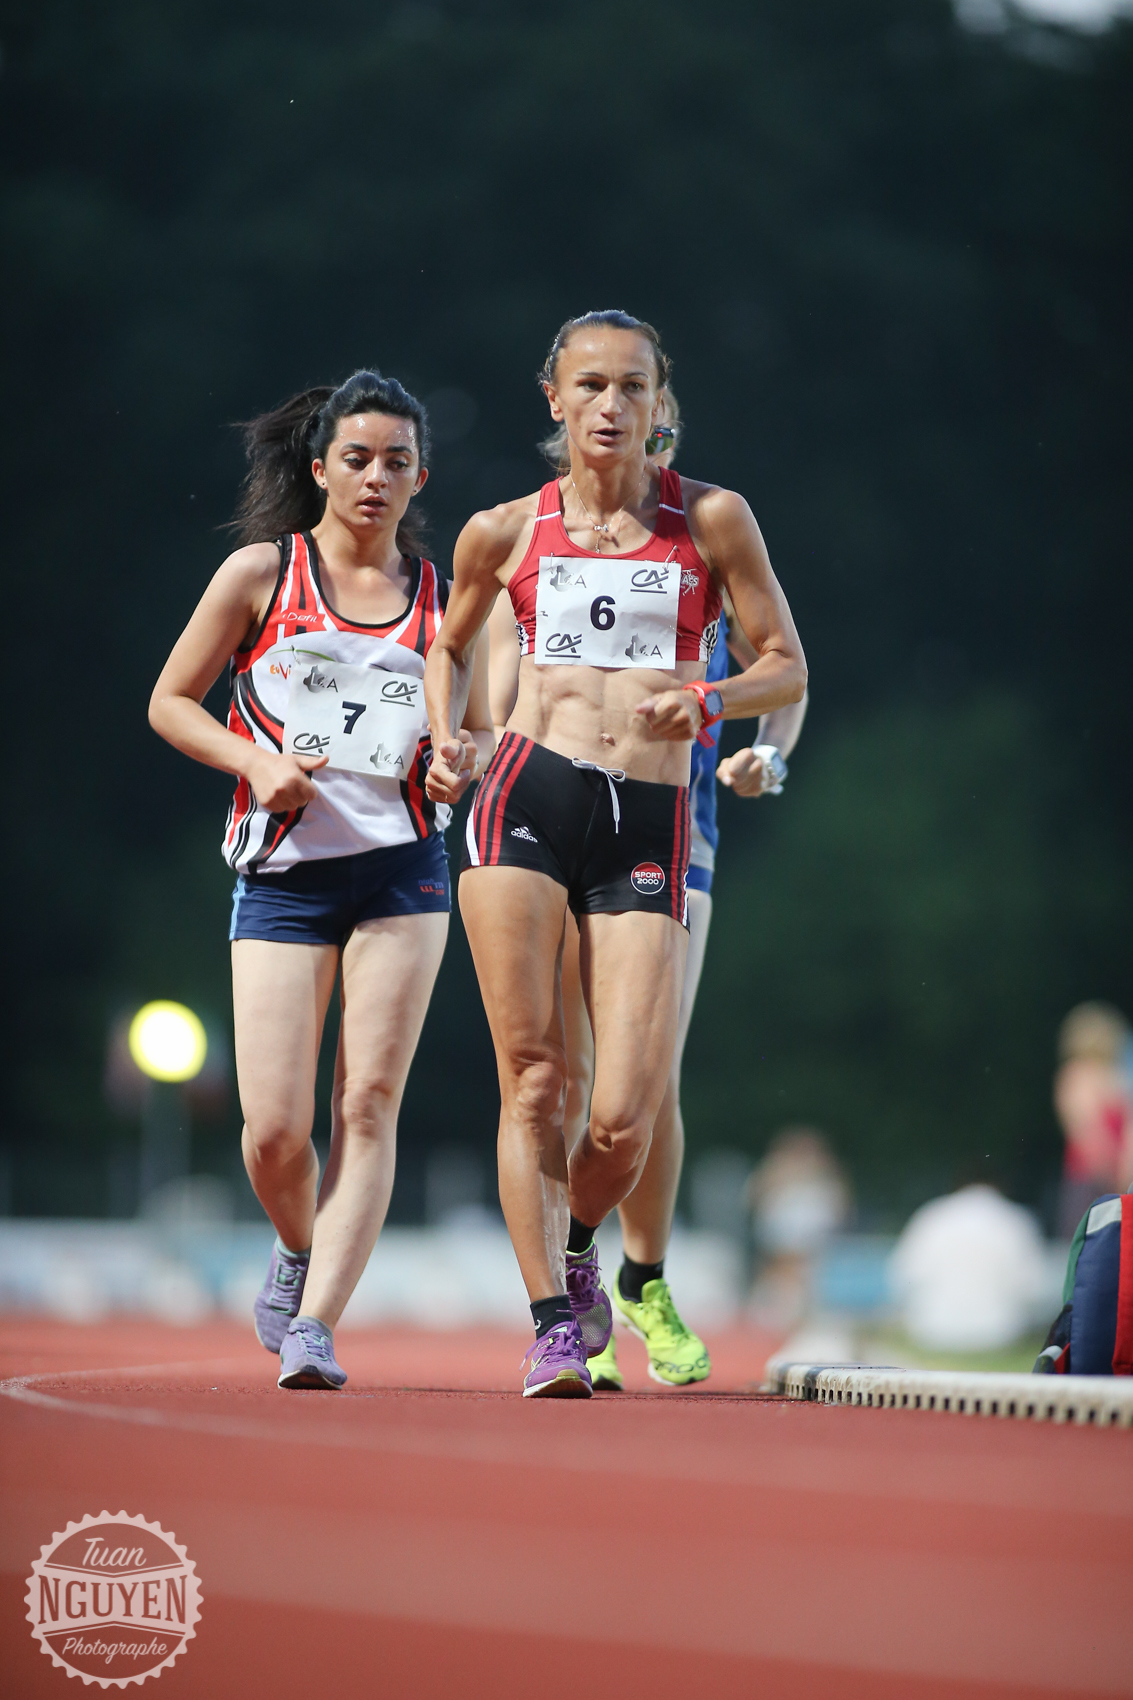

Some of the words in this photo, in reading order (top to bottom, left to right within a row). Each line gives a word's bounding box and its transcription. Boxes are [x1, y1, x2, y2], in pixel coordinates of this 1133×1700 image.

[590, 595, 616, 631] 6
[342, 701, 367, 735] 7
[510, 830, 539, 843] adidas
[634, 871, 662, 879] SPORT
[636, 878, 660, 886] 2000
